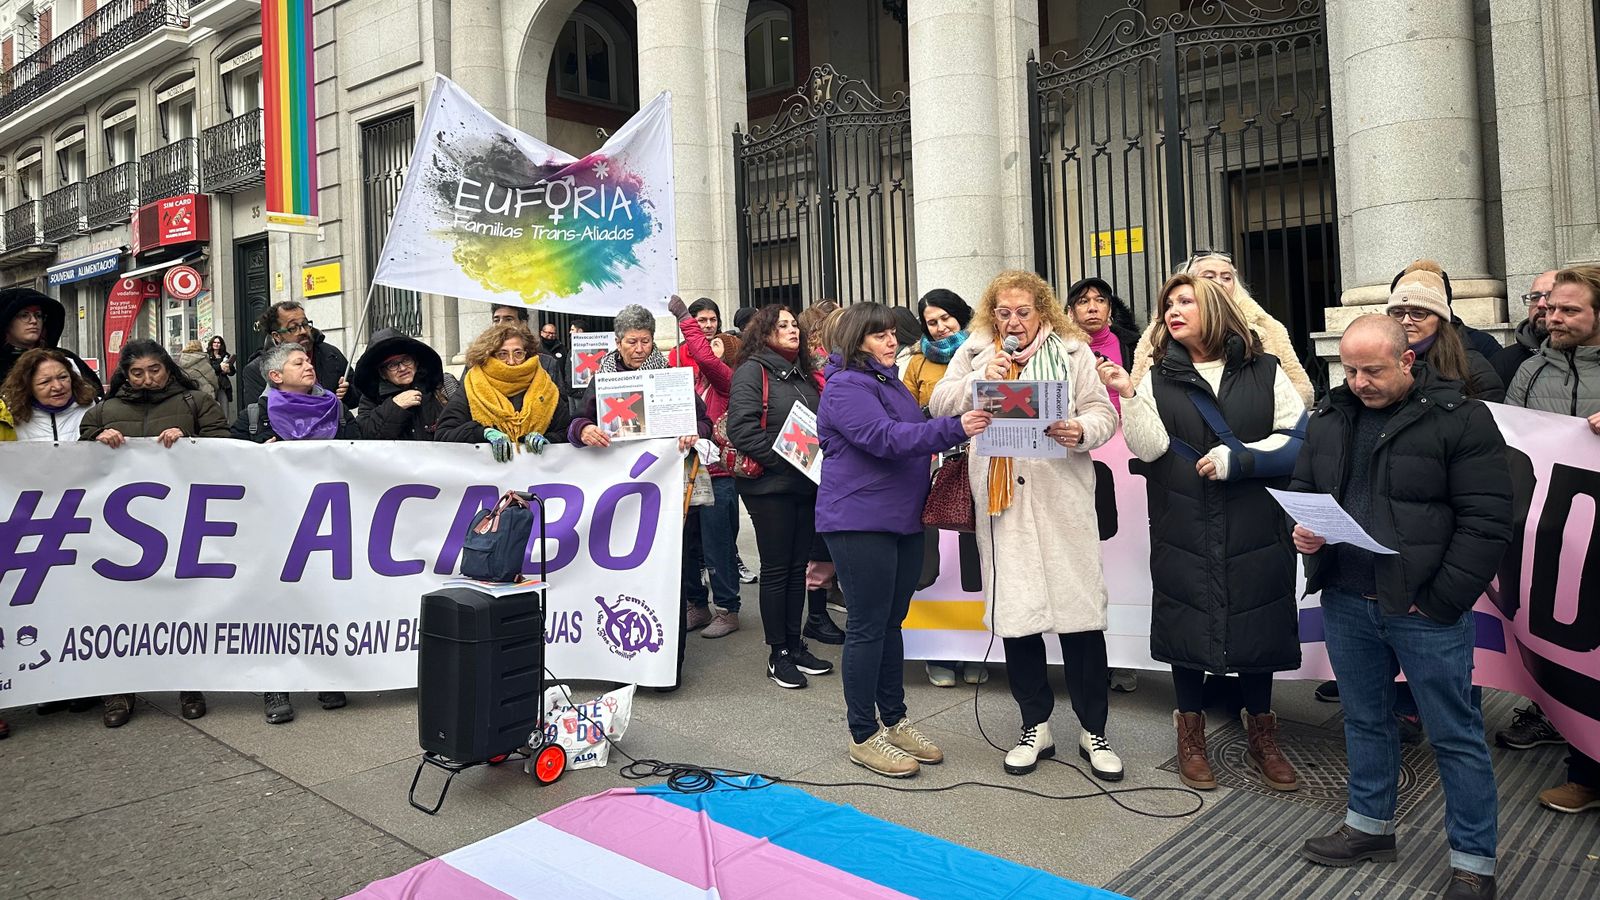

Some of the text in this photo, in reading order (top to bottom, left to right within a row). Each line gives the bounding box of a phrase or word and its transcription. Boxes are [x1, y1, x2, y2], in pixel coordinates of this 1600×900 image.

[813, 74, 833, 103] 37
[163, 198, 192, 209] SIM CARD
[252, 206, 260, 219] 35
[454, 175, 633, 225] EUFORIA
[452, 213, 635, 241] Familias Trans-Aliadas
[50, 269, 75, 284] SOUVENIR
[0, 451, 661, 606] #SE ACABÓ
[59, 610, 583, 662] ASOCIACION FEMINISTAS SAN BL JAS
[574, 752, 597, 764] ALDI
